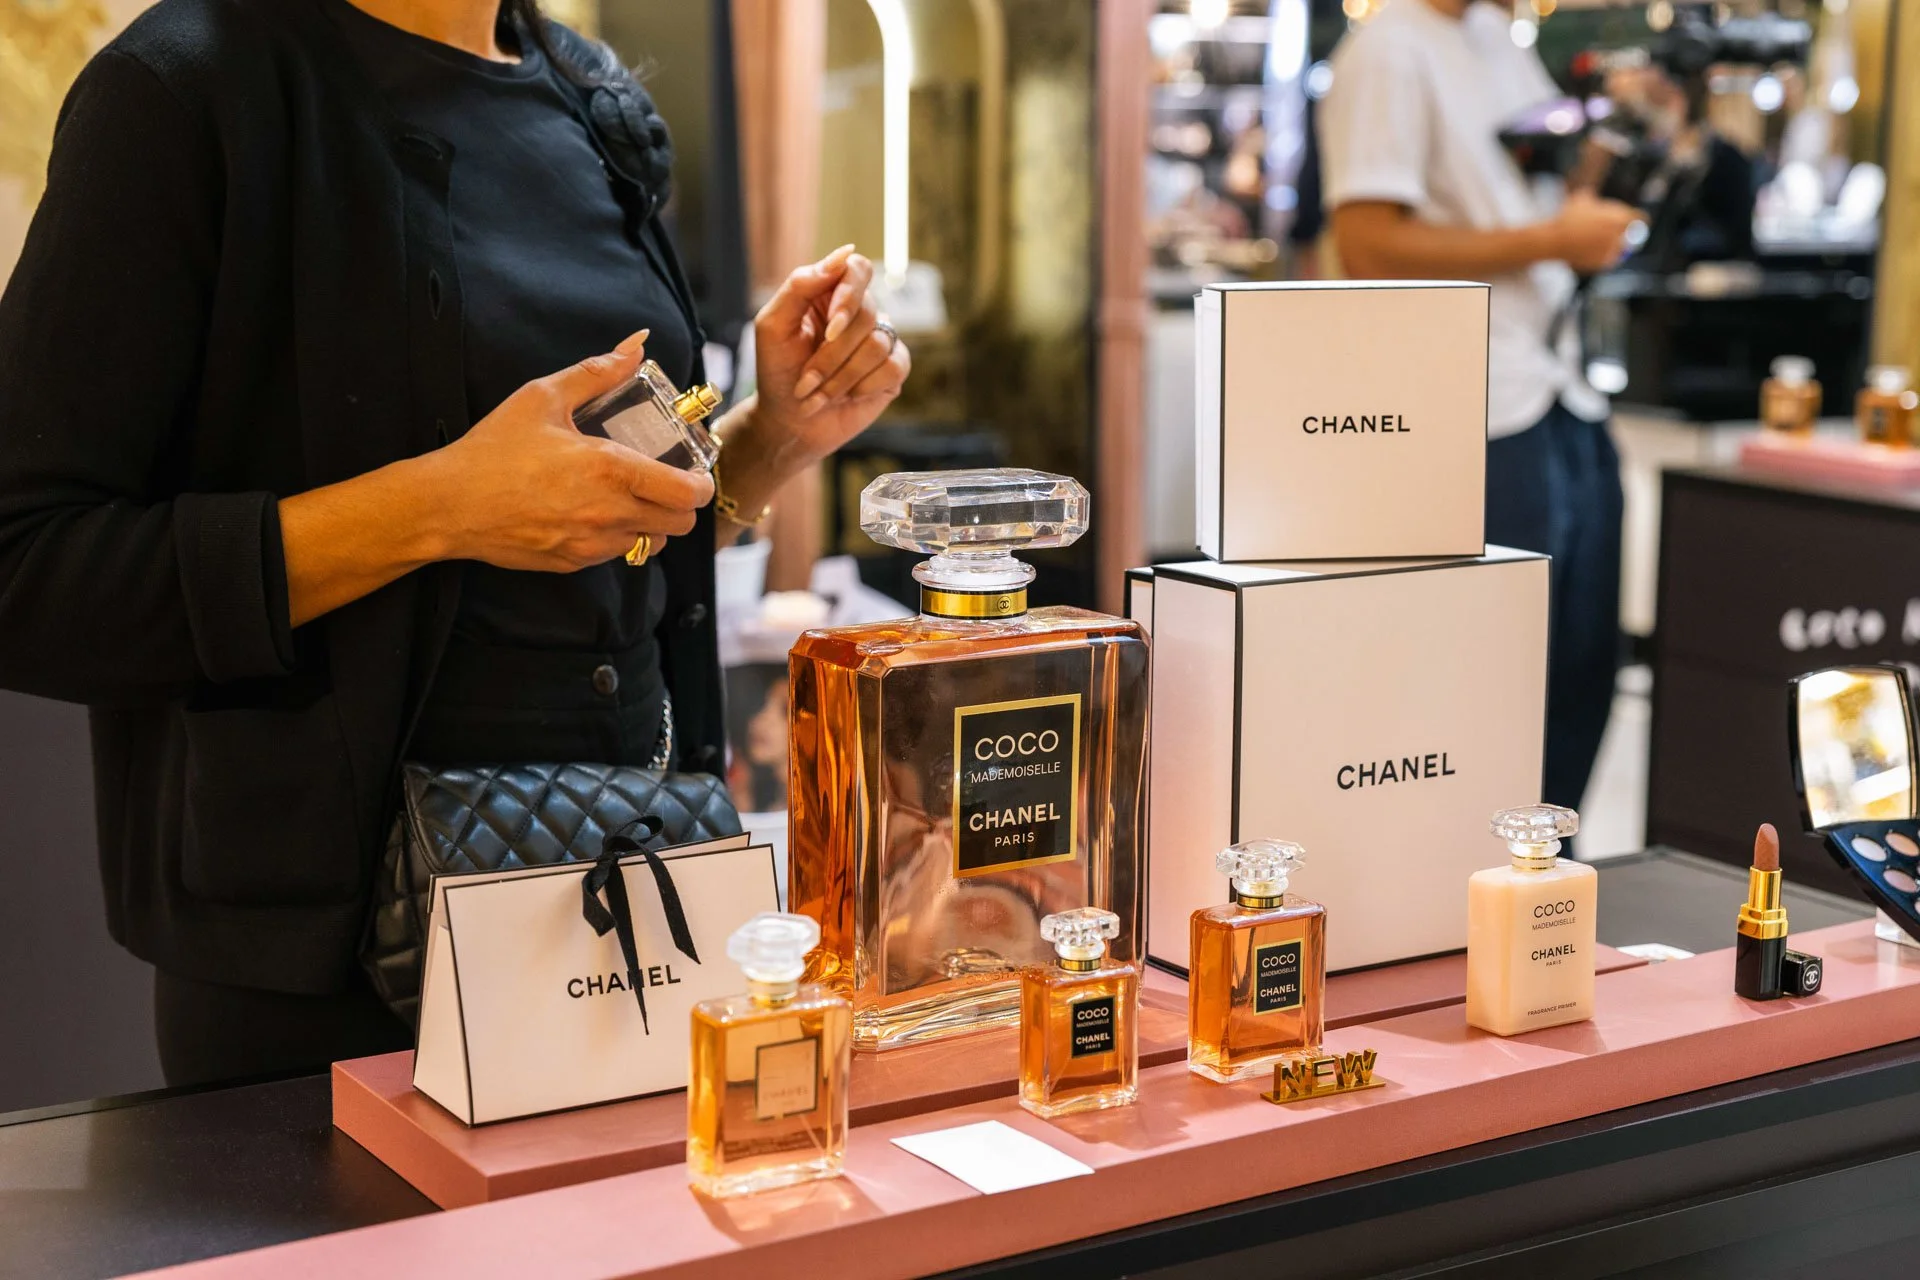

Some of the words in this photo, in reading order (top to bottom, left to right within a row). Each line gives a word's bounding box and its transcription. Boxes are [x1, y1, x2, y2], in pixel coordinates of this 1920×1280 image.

[1302, 414, 1411, 434] CHANEL
[974, 729, 1059, 761] COCO
[971, 761, 1061, 784] MADEMOISELLE
[1337, 752, 1456, 790] CHANEL
[969, 802, 1061, 832] CHANEL
[994, 832, 1035, 847] PARIS
[1533, 900, 1575, 918] COCO
[1532, 917, 1576, 930] MADEMOISELLE
[1531, 944, 1576, 961] CHANEL
[1262, 953, 1296, 969] COCO
[1546, 959, 1562, 967] PARIS
[1260, 983, 1297, 998] CHANEL
[1077, 1007, 1109, 1020] COCO
[1527, 1005, 1558, 1016] FRAGRANCE
[1076, 1032, 1110, 1045] CHANEL
[1273, 1048, 1378, 1100] NEW
